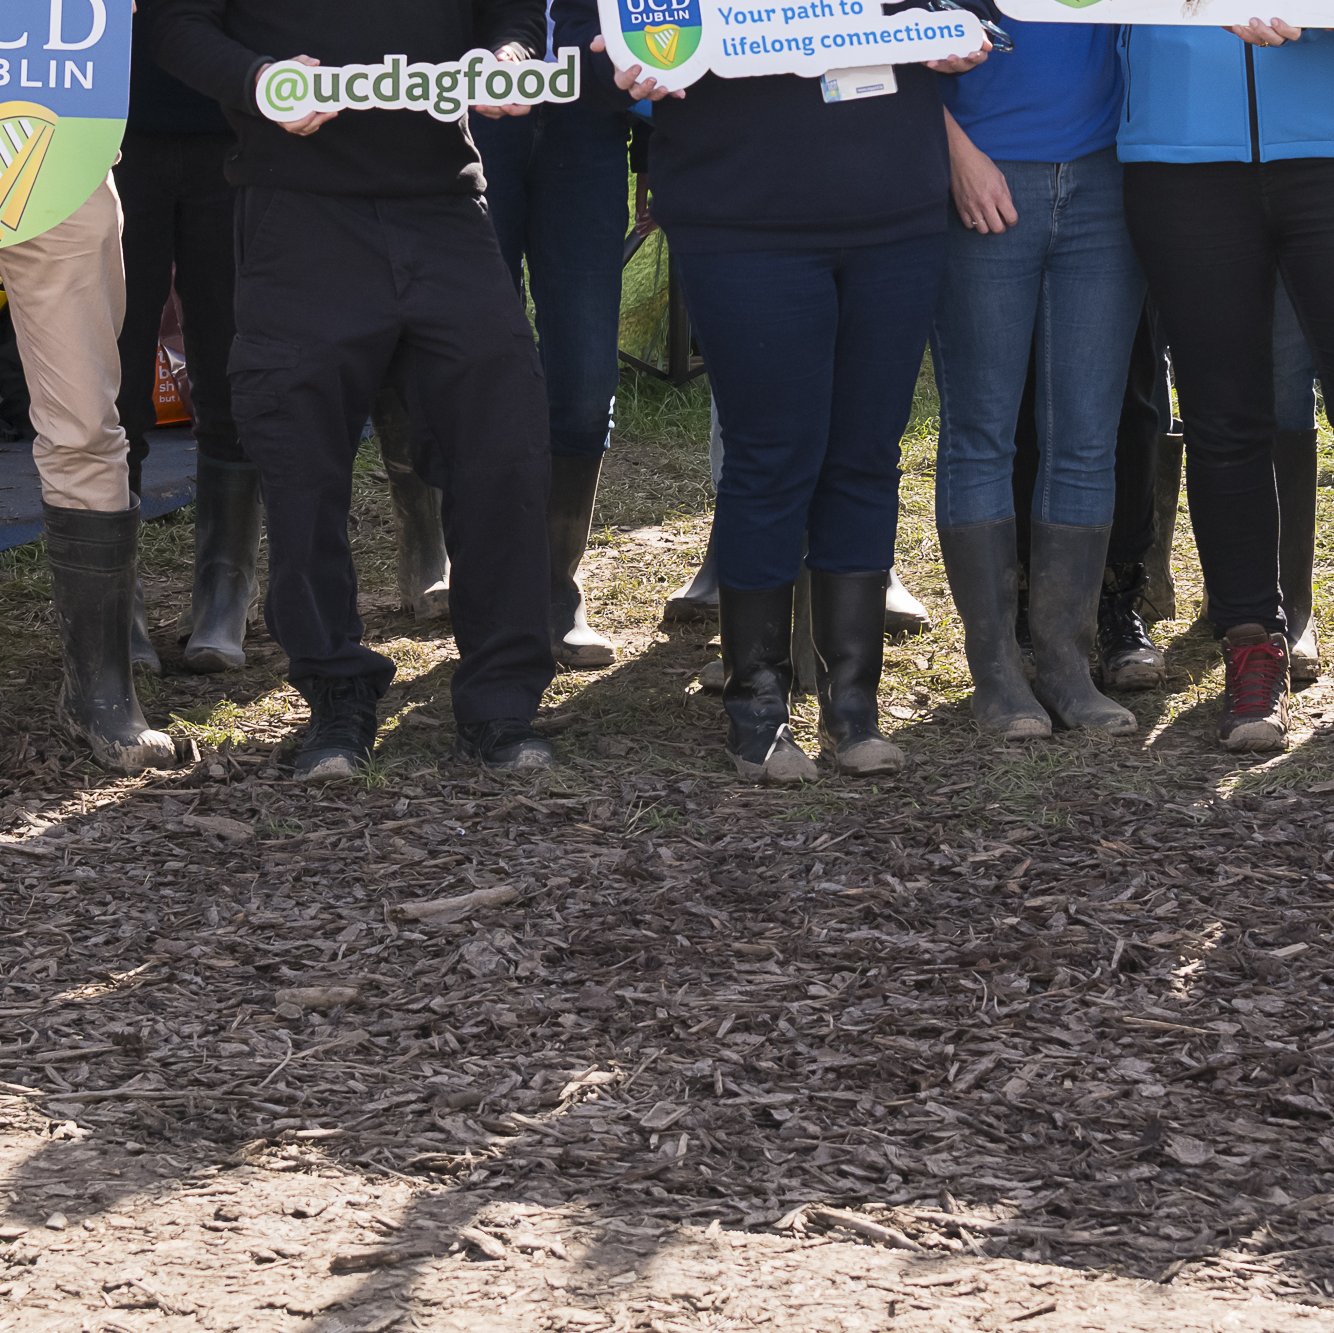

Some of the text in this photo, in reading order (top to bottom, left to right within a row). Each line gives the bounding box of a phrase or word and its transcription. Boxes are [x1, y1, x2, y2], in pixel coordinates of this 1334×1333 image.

[631, 9, 690, 24] DUBLIN
[718, 0, 864, 31] Your path to
[722, 22, 965, 57] lifelong connections
[265, 54, 576, 115] @ucdagfood
[159, 380, 175, 393] sh
[159, 395, 176, 403] but
